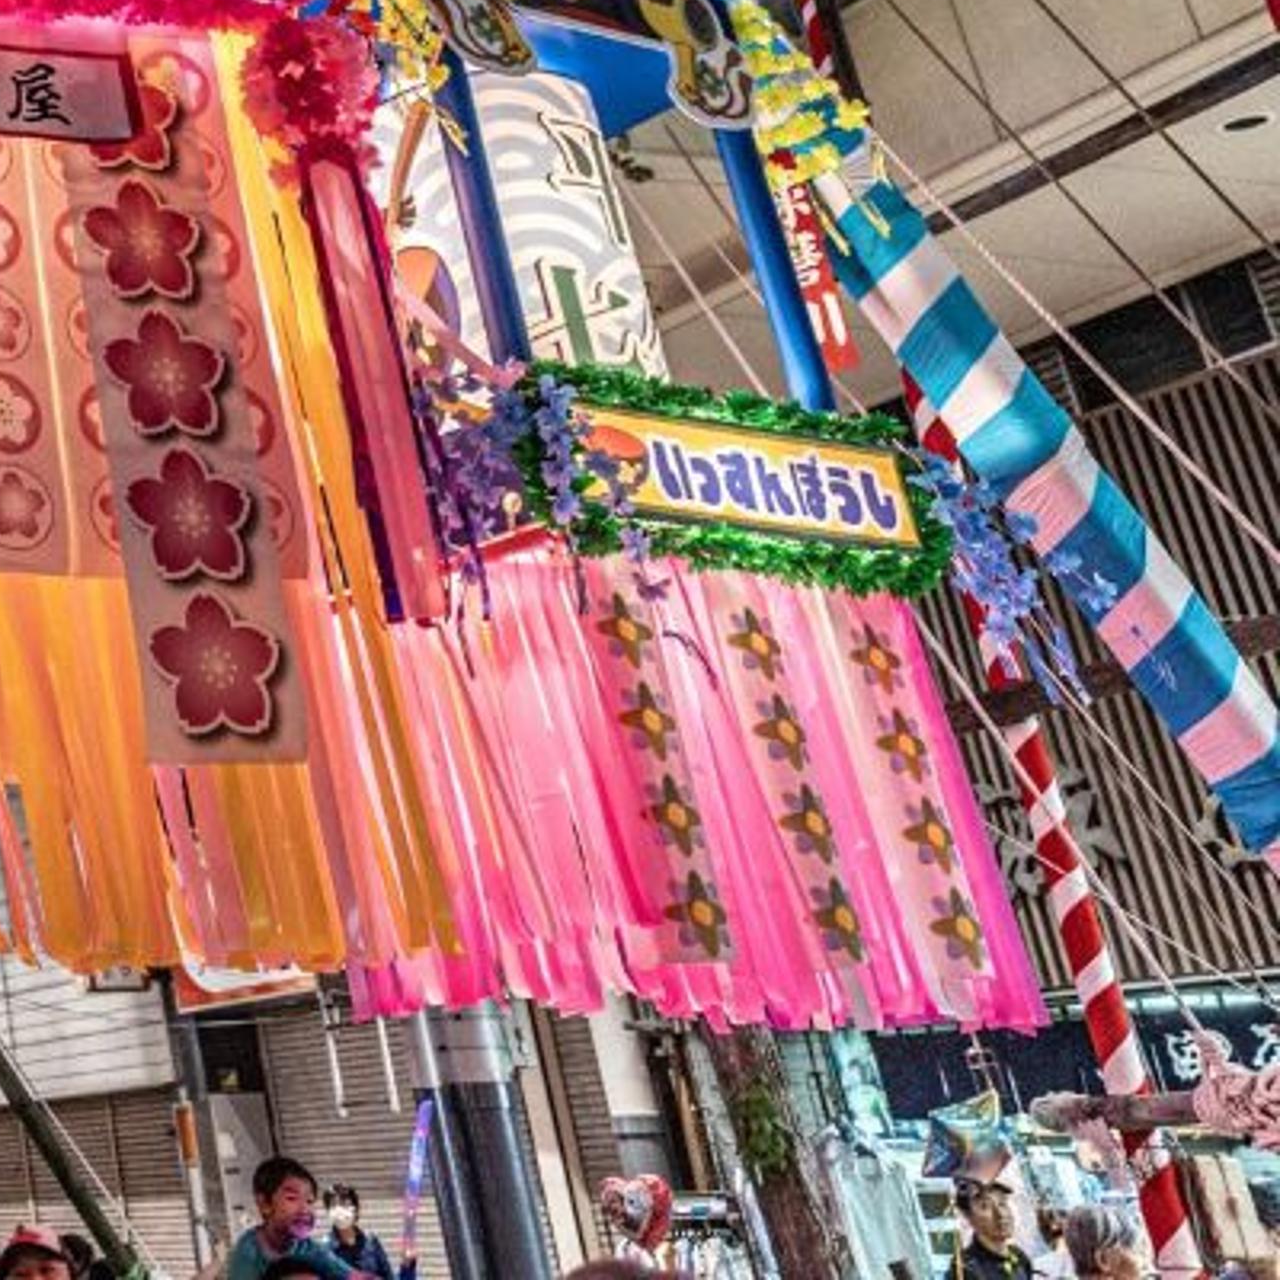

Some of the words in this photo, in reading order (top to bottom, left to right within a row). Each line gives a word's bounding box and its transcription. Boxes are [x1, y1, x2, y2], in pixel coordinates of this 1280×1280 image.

[650, 438, 898, 532] いっすんぼうし
